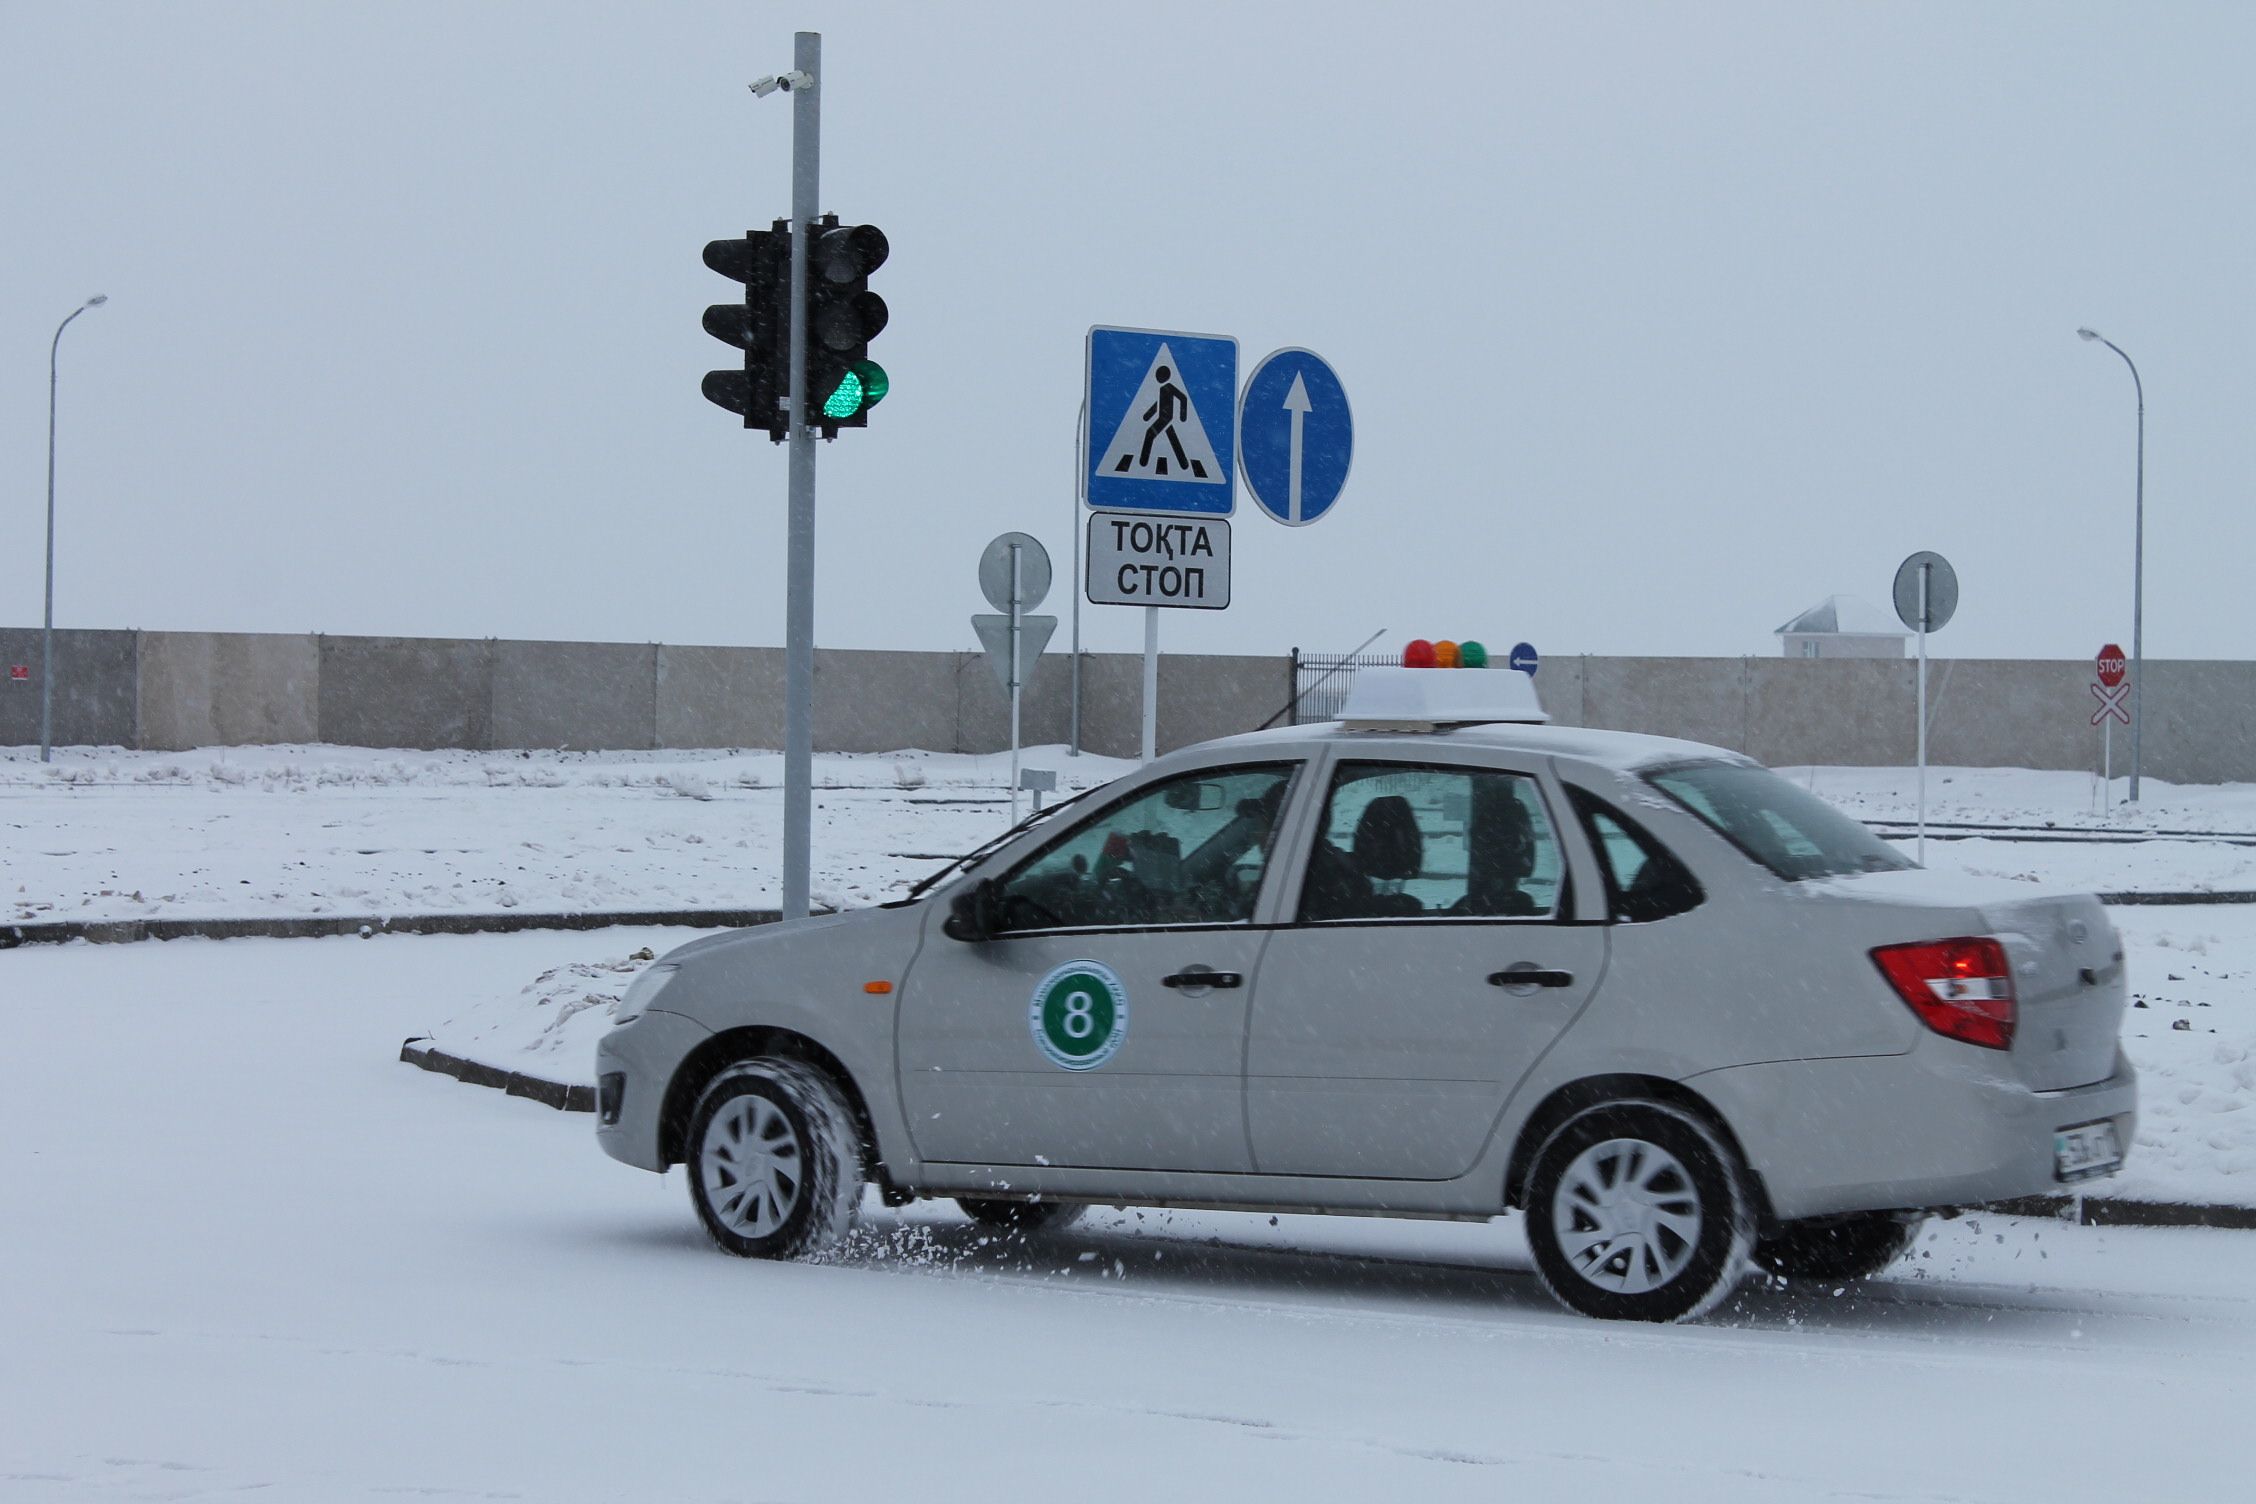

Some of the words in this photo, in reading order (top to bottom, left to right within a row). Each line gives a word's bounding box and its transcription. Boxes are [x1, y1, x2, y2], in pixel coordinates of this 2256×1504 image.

[1111, 520, 1213, 560] ТОҚТА
[1117, 563, 1204, 598] СТОП
[2099, 659, 2124, 673] STOP
[1063, 991, 1094, 1038] 8
